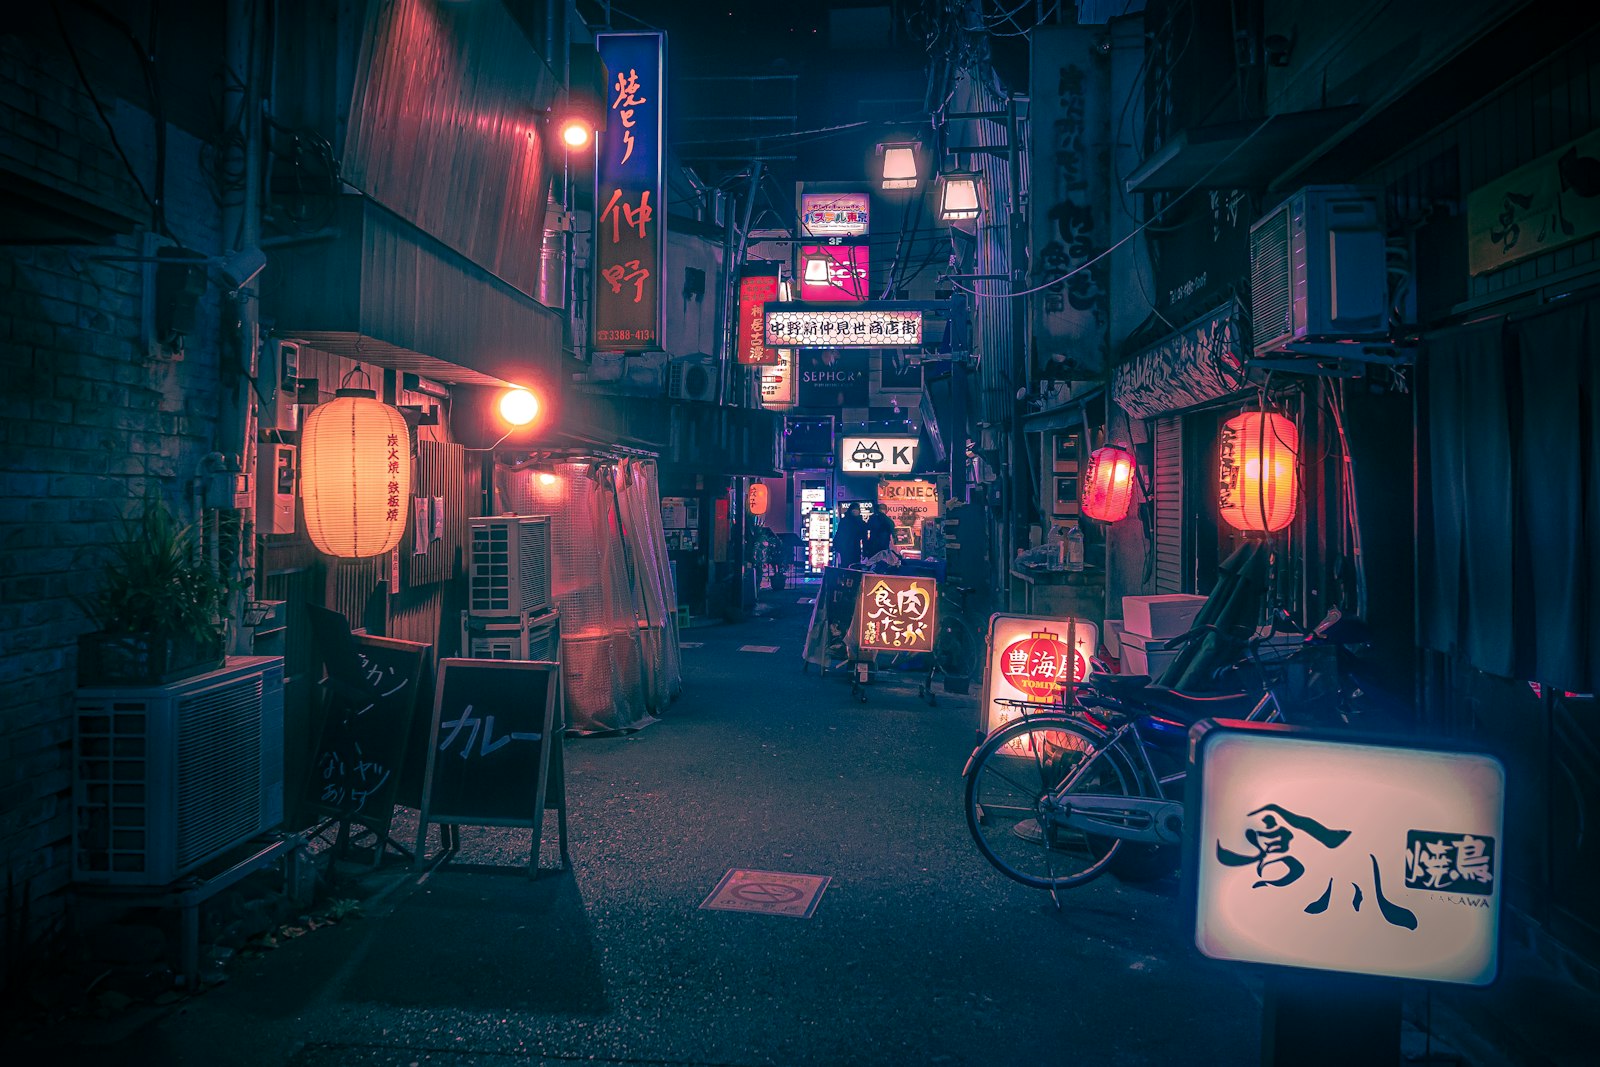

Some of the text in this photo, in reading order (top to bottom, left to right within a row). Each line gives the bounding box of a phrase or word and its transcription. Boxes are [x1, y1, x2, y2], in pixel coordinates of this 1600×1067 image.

[600, 69, 652, 303] 焼とり 仲野
[804, 211, 868, 223] パステル東京
[828, 237, 842, 245] 3F
[770, 320, 917, 336] 中野新仲見世商店街
[892, 446, 916, 465] K
[386, 434, 399, 522] 炭火焼・鉄板焼
[867, 580, 905, 647] 食べたい。
[897, 582, 930, 646] 肉が
[1005, 650, 1080, 680] 豊海屋
[1022, 679, 1062, 691] TOMIYA
[441, 704, 542, 760] カレー
[1405, 834, 1493, 888] 焼鳥
